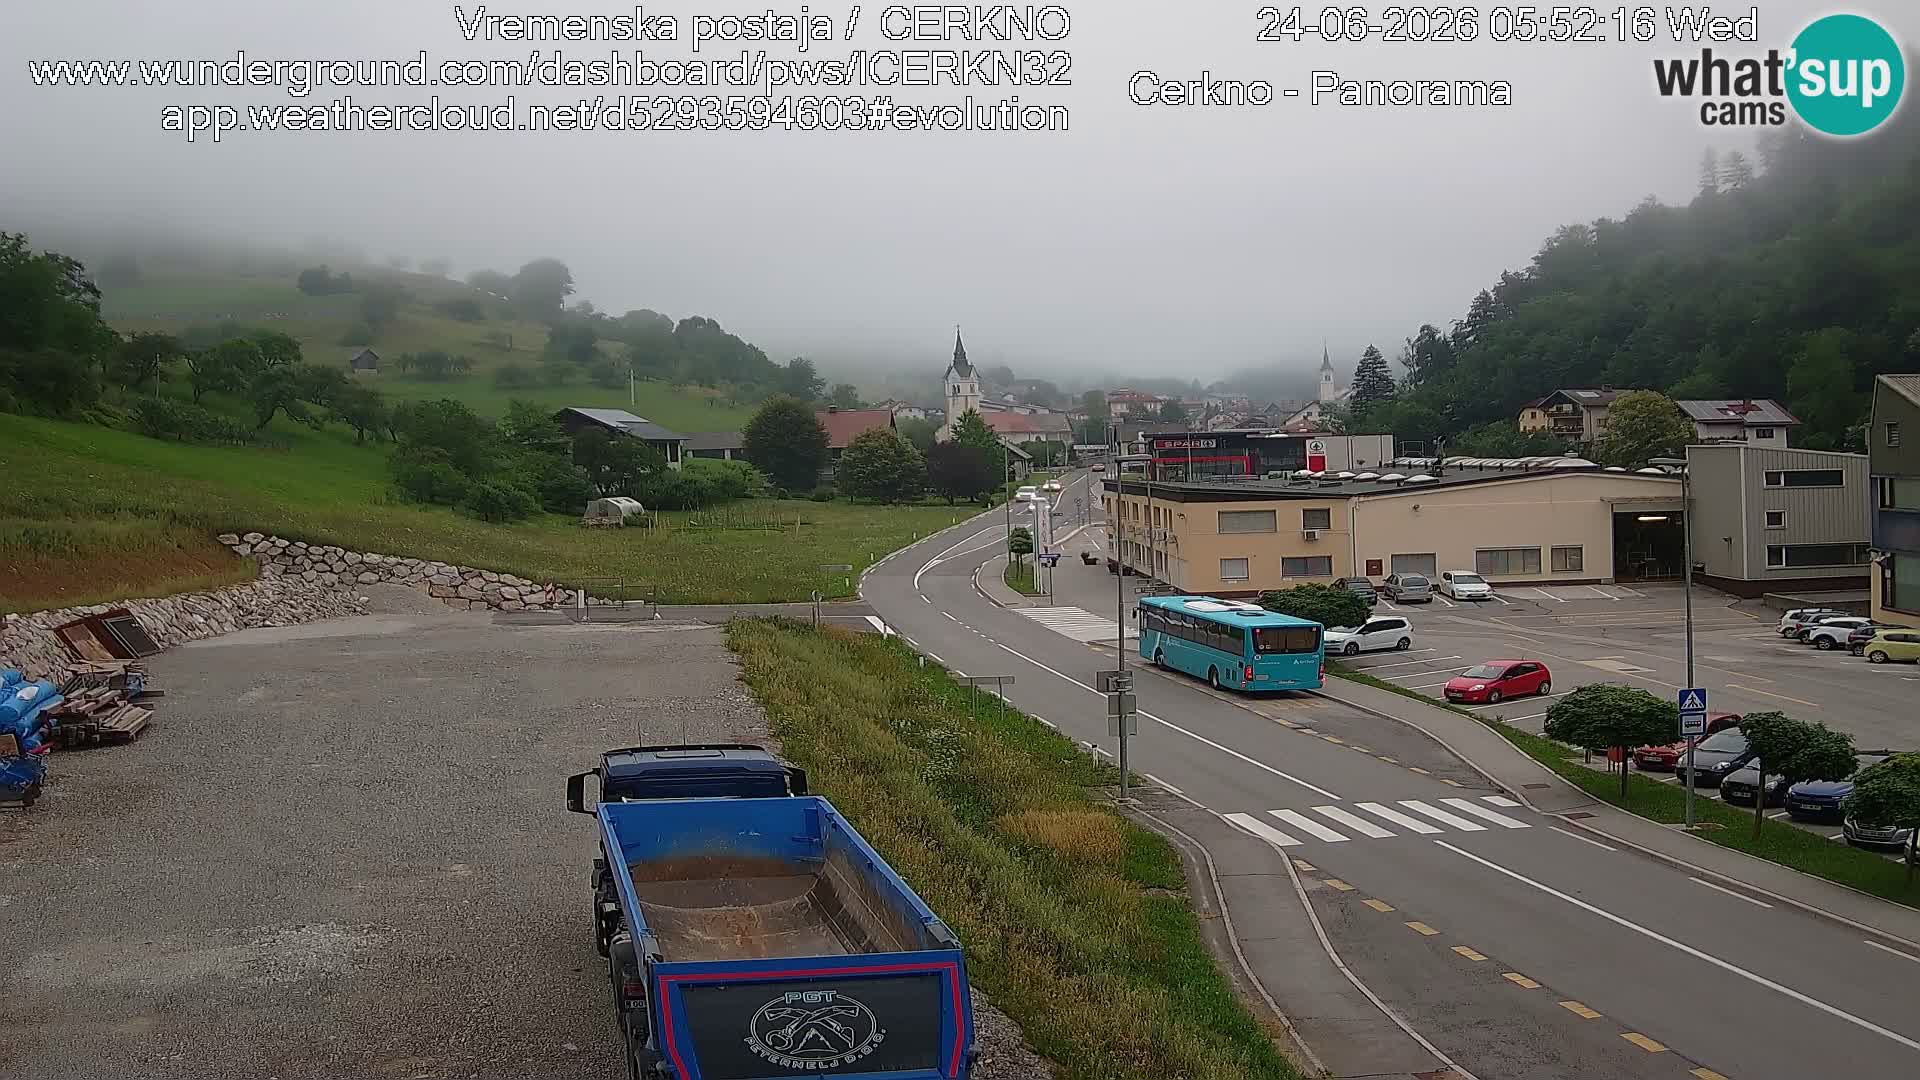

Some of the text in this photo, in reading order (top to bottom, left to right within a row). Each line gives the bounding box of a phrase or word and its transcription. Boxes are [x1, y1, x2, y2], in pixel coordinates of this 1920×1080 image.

[1165, 440, 1201, 448] SPAR
[784, 990, 837, 1004] PGT
[744, 1036, 839, 1070] PETERNELJ
